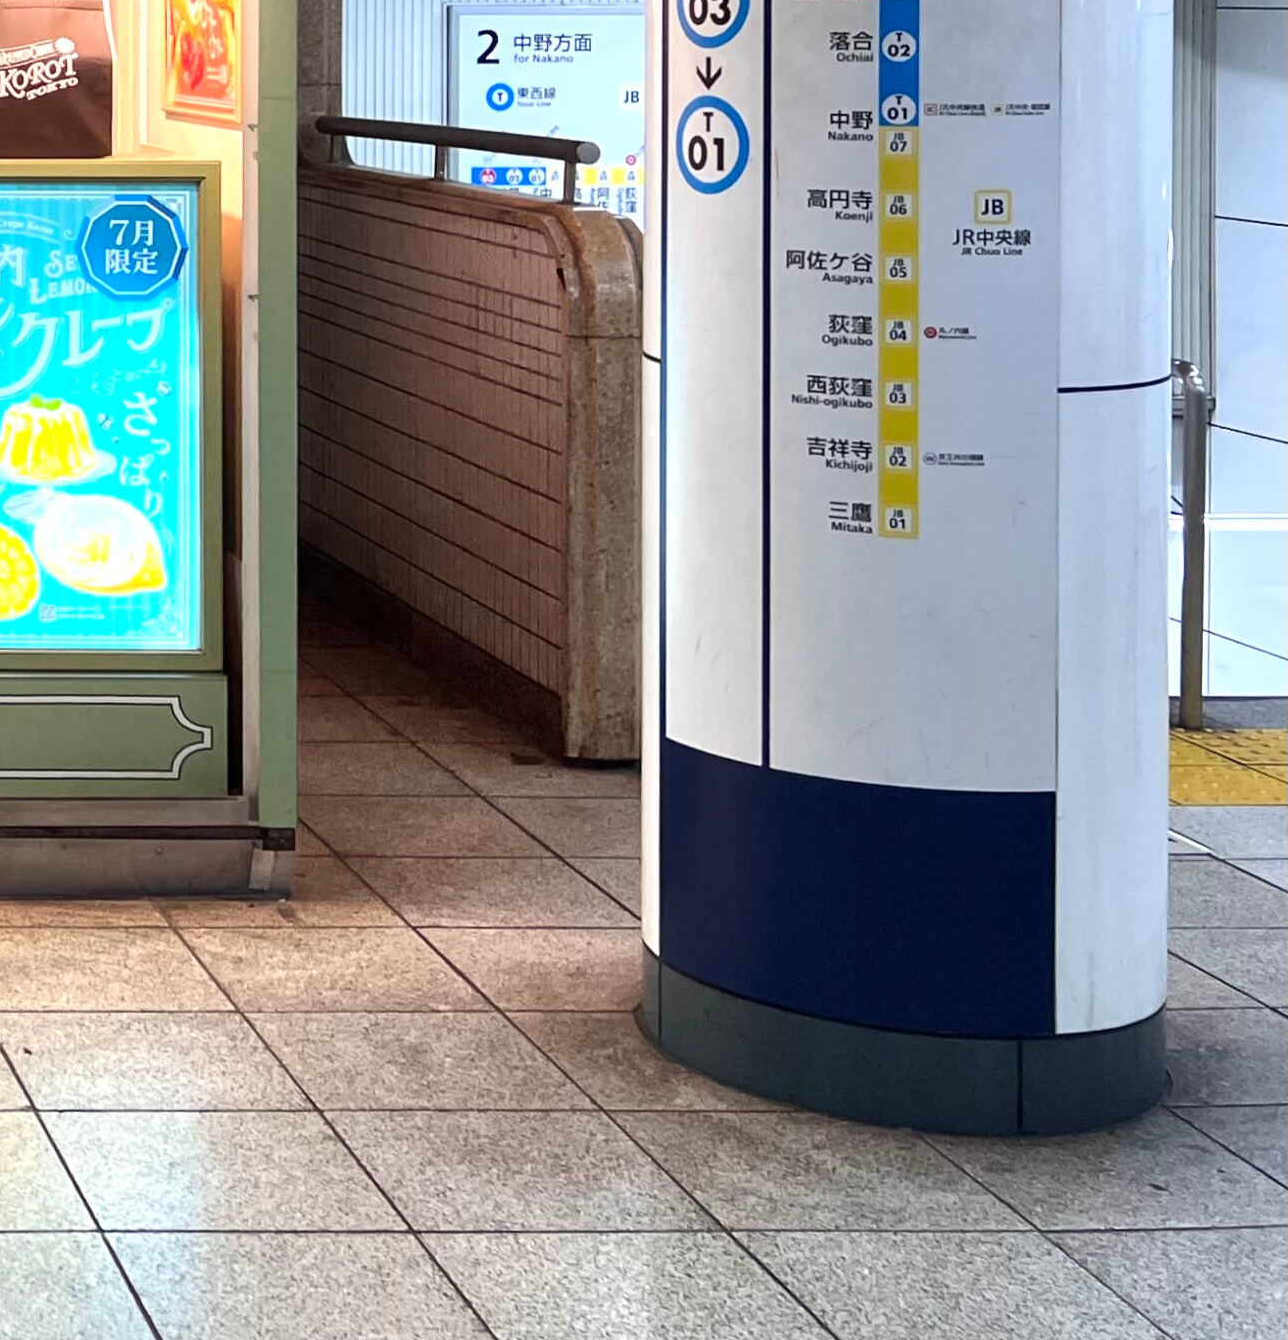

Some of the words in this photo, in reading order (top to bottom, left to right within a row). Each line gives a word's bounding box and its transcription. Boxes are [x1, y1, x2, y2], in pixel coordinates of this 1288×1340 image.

[477, 29, 500, 64] 2
[513, 34, 593, 53] 中野方面
[829, 32, 873, 51] 落合
[836, 52, 873, 62] Ochiai
[887, 45, 910, 57] 02
[514, 54, 529, 63] for
[533, 54, 574, 63] Nakano
[623, 91, 640, 104] JB
[830, 110, 873, 130] 中野
[887, 108, 908, 120] 01
[703, 112, 714, 132] T
[828, 131, 873, 142] Nakano
[688, 134, 725, 172] 01
[807, 189, 873, 210] 高円寺
[890, 204, 907, 215] 06
[981, 199, 1004, 215] JB
[835, 211, 873, 222] Koenji
[109, 220, 154, 246] 7月
[952, 229, 1031, 246] JR中央線
[105, 248, 159, 275] 限定
[822, 272, 873, 285] Asagaya
[890, 267, 907, 278] 05
[829, 314, 872, 335] 荻窪
[821, 335, 873, 347] Ogikubo
[889, 330, 907, 341] 04
[807, 375, 873, 397] 西荻窪
[791, 394, 873, 409] Nishi-ogikubo
[889, 393, 907, 404] 03
[807, 437, 872, 460] 吉祥寺
[825, 459, 873, 472] Kichijoji
[889, 456, 907, 467] 02
[829, 501, 872, 523] 三鷹
[831, 522, 873, 534] Mitaka
[889, 519, 906, 529] 01
